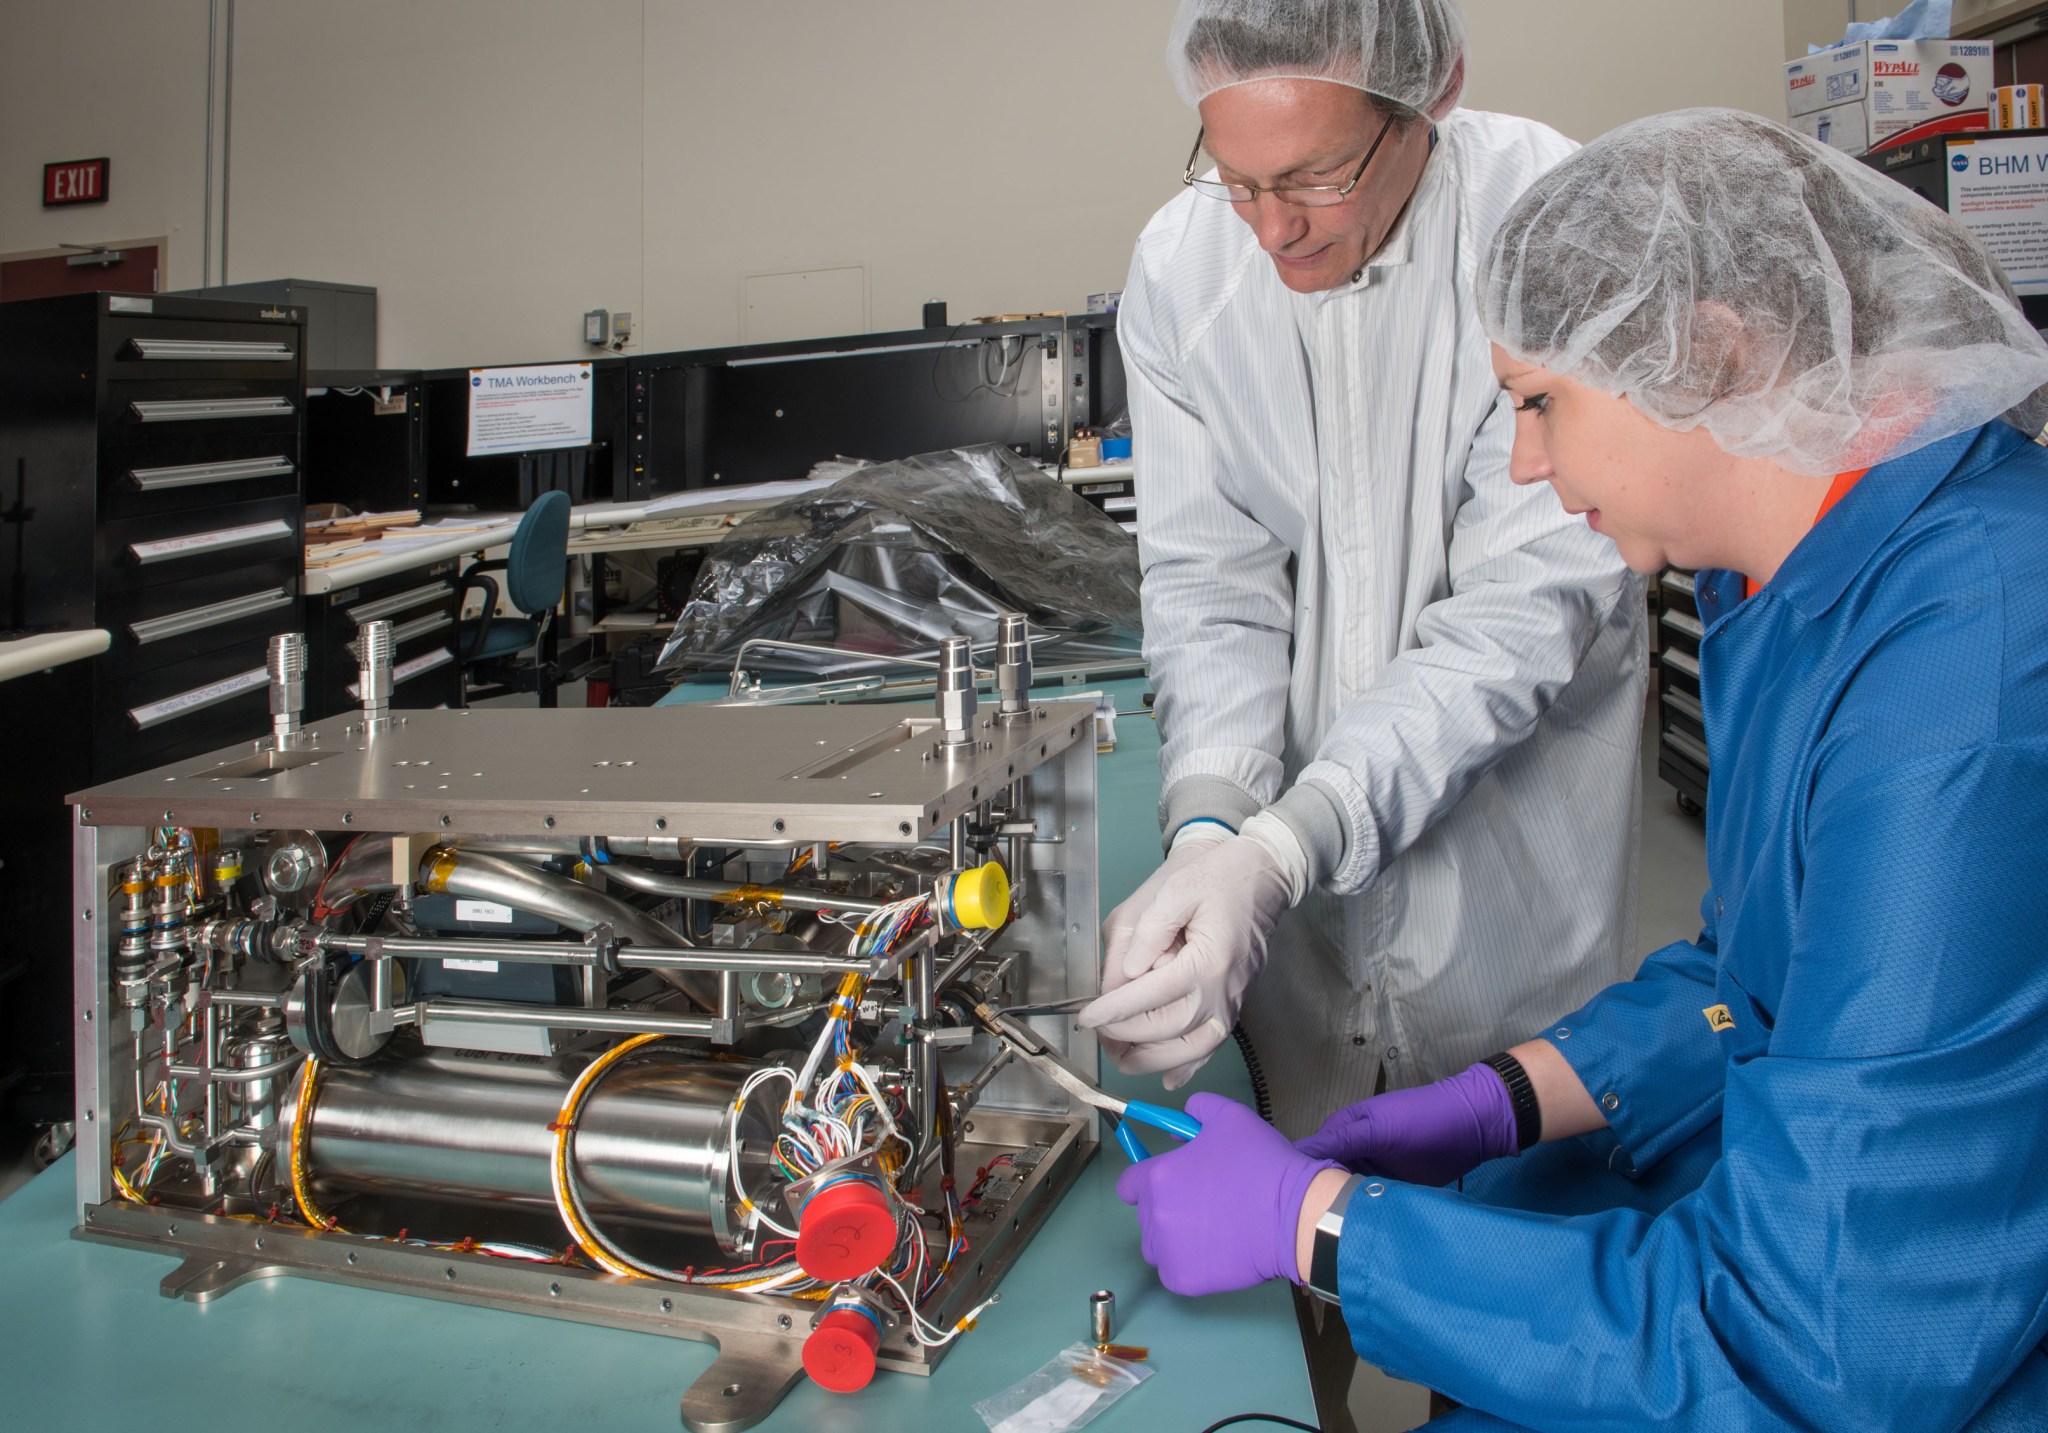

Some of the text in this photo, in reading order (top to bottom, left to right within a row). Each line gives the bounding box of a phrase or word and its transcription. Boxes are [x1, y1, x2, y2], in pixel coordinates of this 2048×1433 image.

[1980, 154, 2029, 175] BHM
[54, 166, 96, 198] EXIT
[488, 377, 514, 388] TMA
[516, 374, 576, 386] Workbench
